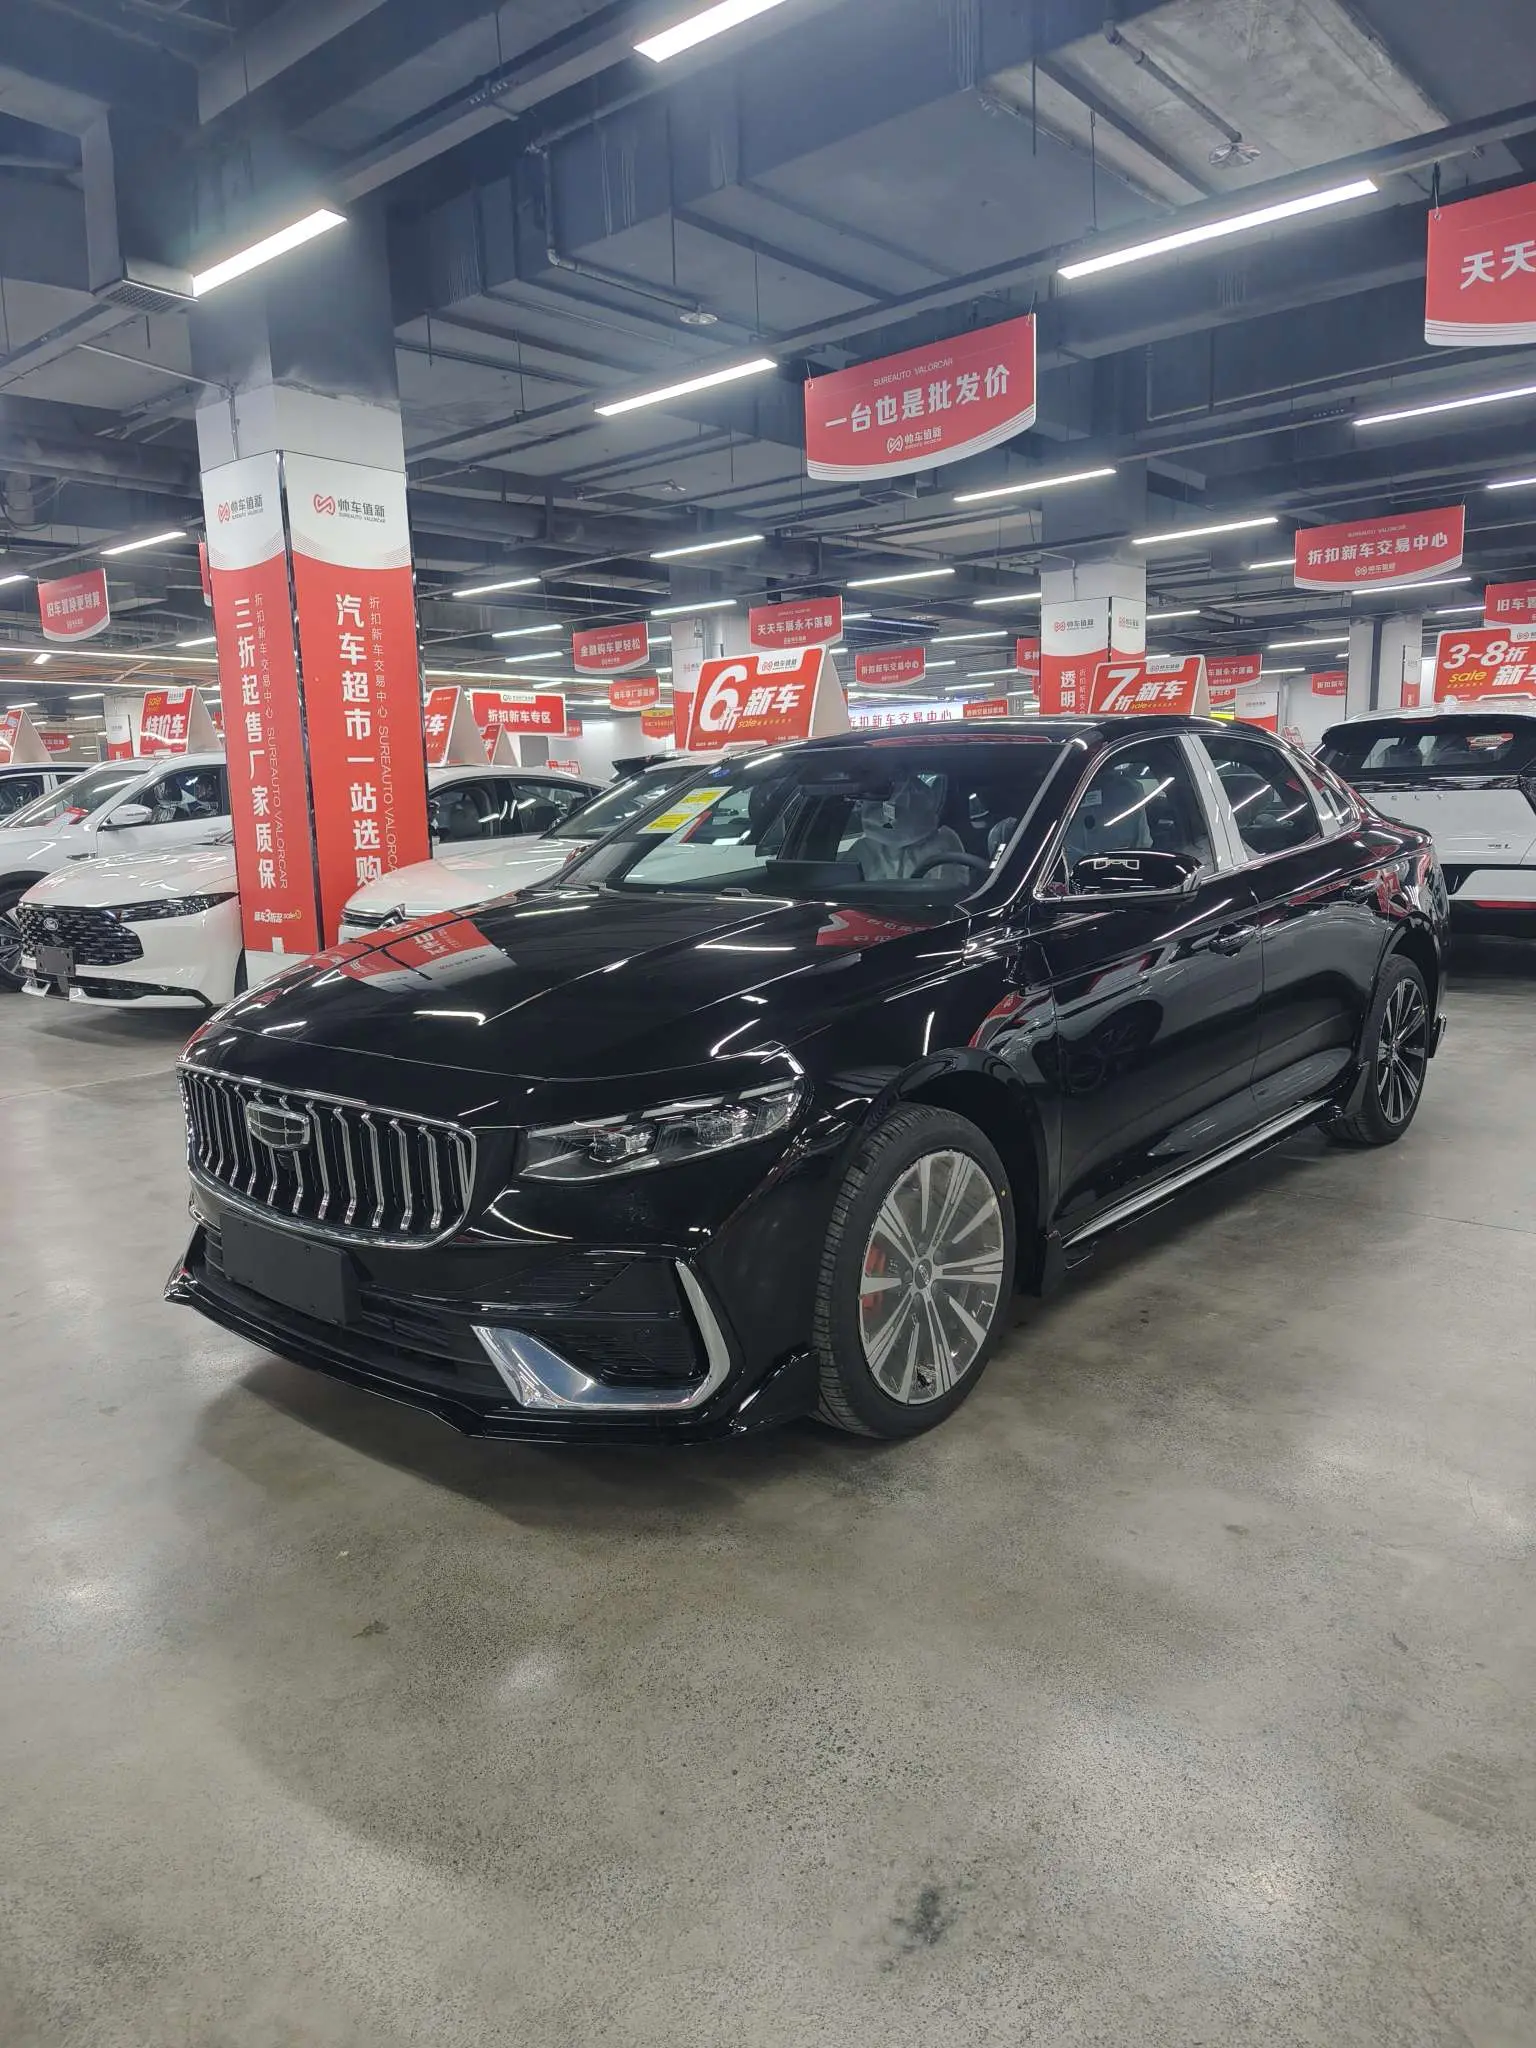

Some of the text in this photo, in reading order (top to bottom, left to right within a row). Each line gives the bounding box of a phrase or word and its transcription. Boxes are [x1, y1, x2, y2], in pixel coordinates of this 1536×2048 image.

[1460, 240, 1536, 290] 天天
[825, 364, 1010, 433] 一台也是批发价
[337, 498, 385, 518] 帅车值新
[1307, 531, 1448, 566] 折扣新车交易中心
[254, 593, 273, 719] 折扣新车交易中心
[369, 595, 388, 719] 折扣新车交易中心
[1448, 670, 1488, 684] sale
[743, 683, 806, 716] 新车
[1060, 670, 1076, 714] 透明
[1134, 680, 1188, 701] 新车
[336, 593, 383, 887] 汽车超市一站选购
[487, 708, 552, 724] 折扣新车专区
[235, 597, 276, 889] 三折起售厂家质保
[378, 726, 394, 805] SUREAUTO
[273, 810, 287, 889] VALORCAR
